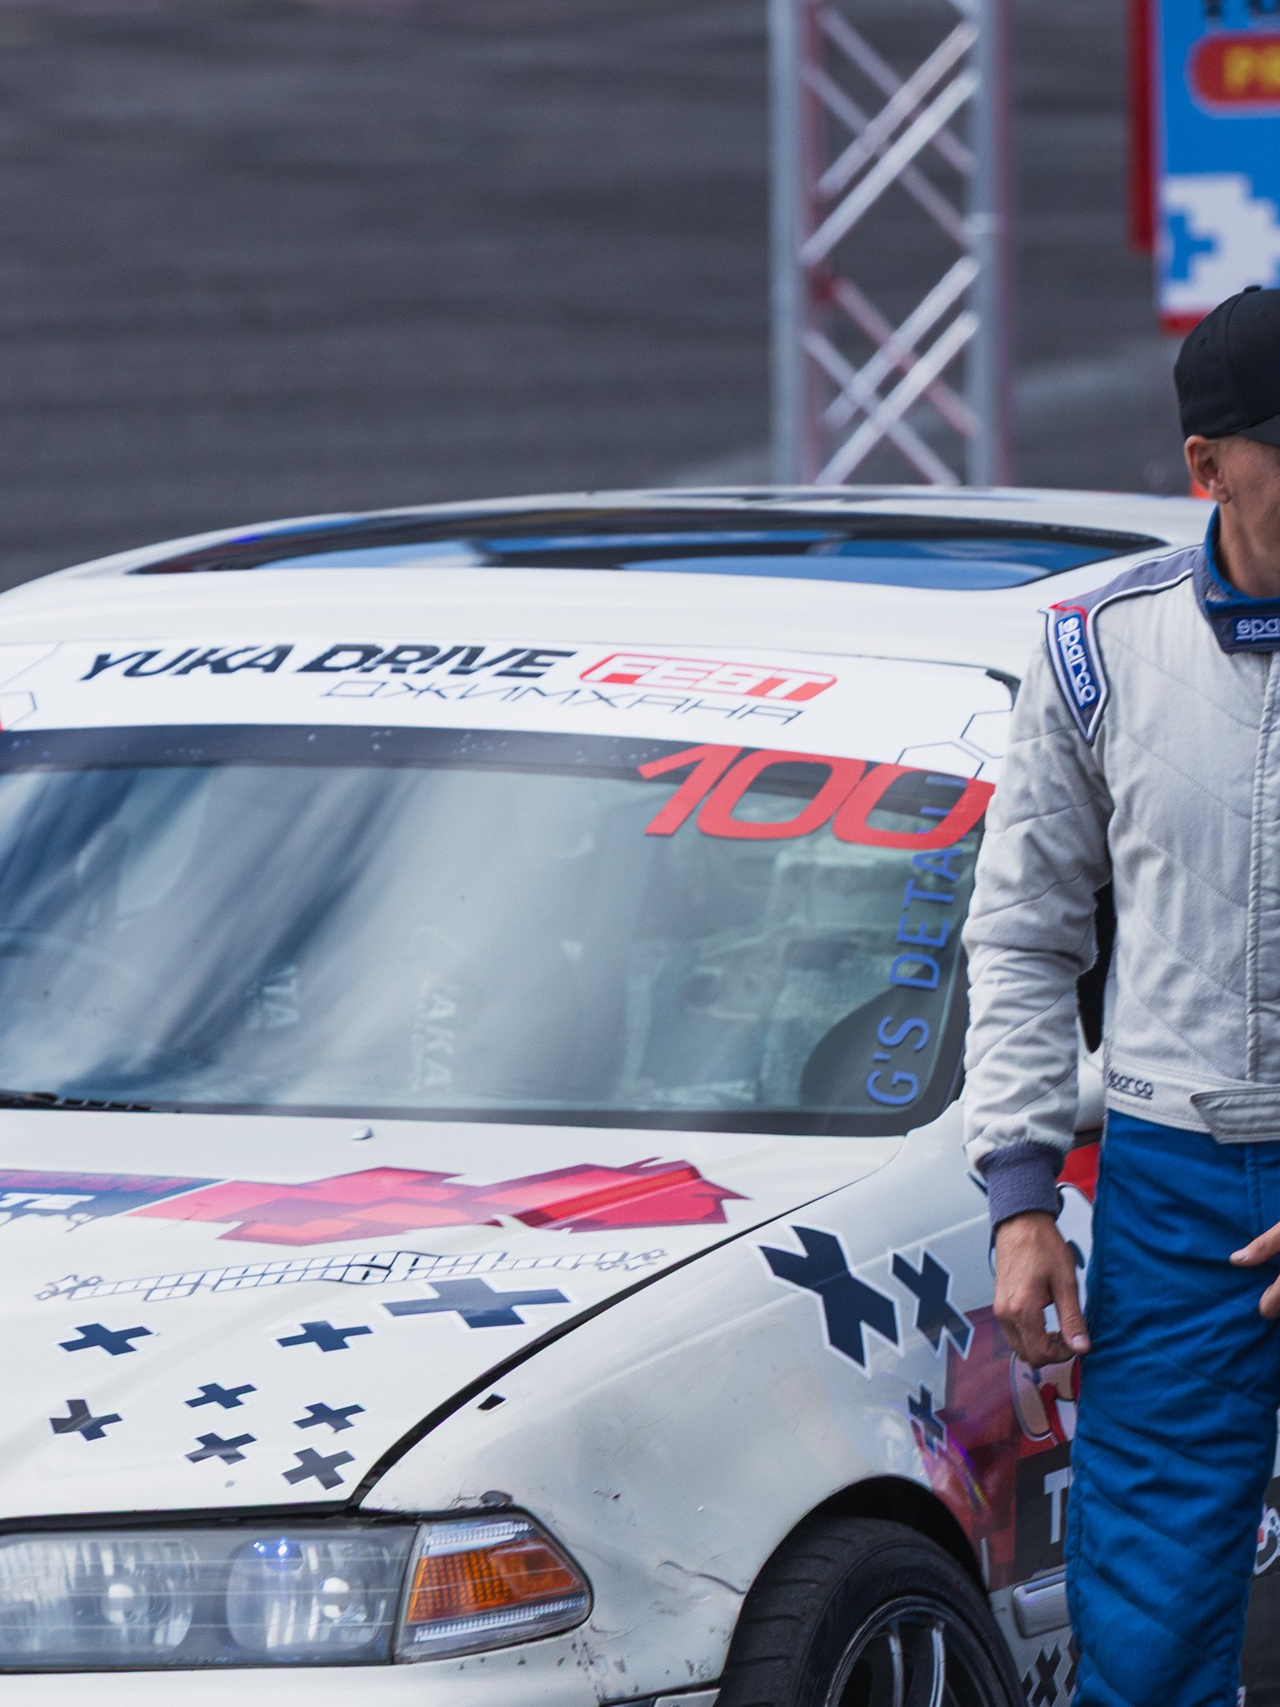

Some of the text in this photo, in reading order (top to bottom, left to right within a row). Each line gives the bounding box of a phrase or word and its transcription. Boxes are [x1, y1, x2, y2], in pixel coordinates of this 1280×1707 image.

[79, 644, 836, 701] YUKA DRIVE FEST
[1056, 617, 1097, 706] sparco
[637, 743, 997, 850] 100
[866, 1014, 930, 1105] G'S
[1107, 1069, 1154, 1101] parco
